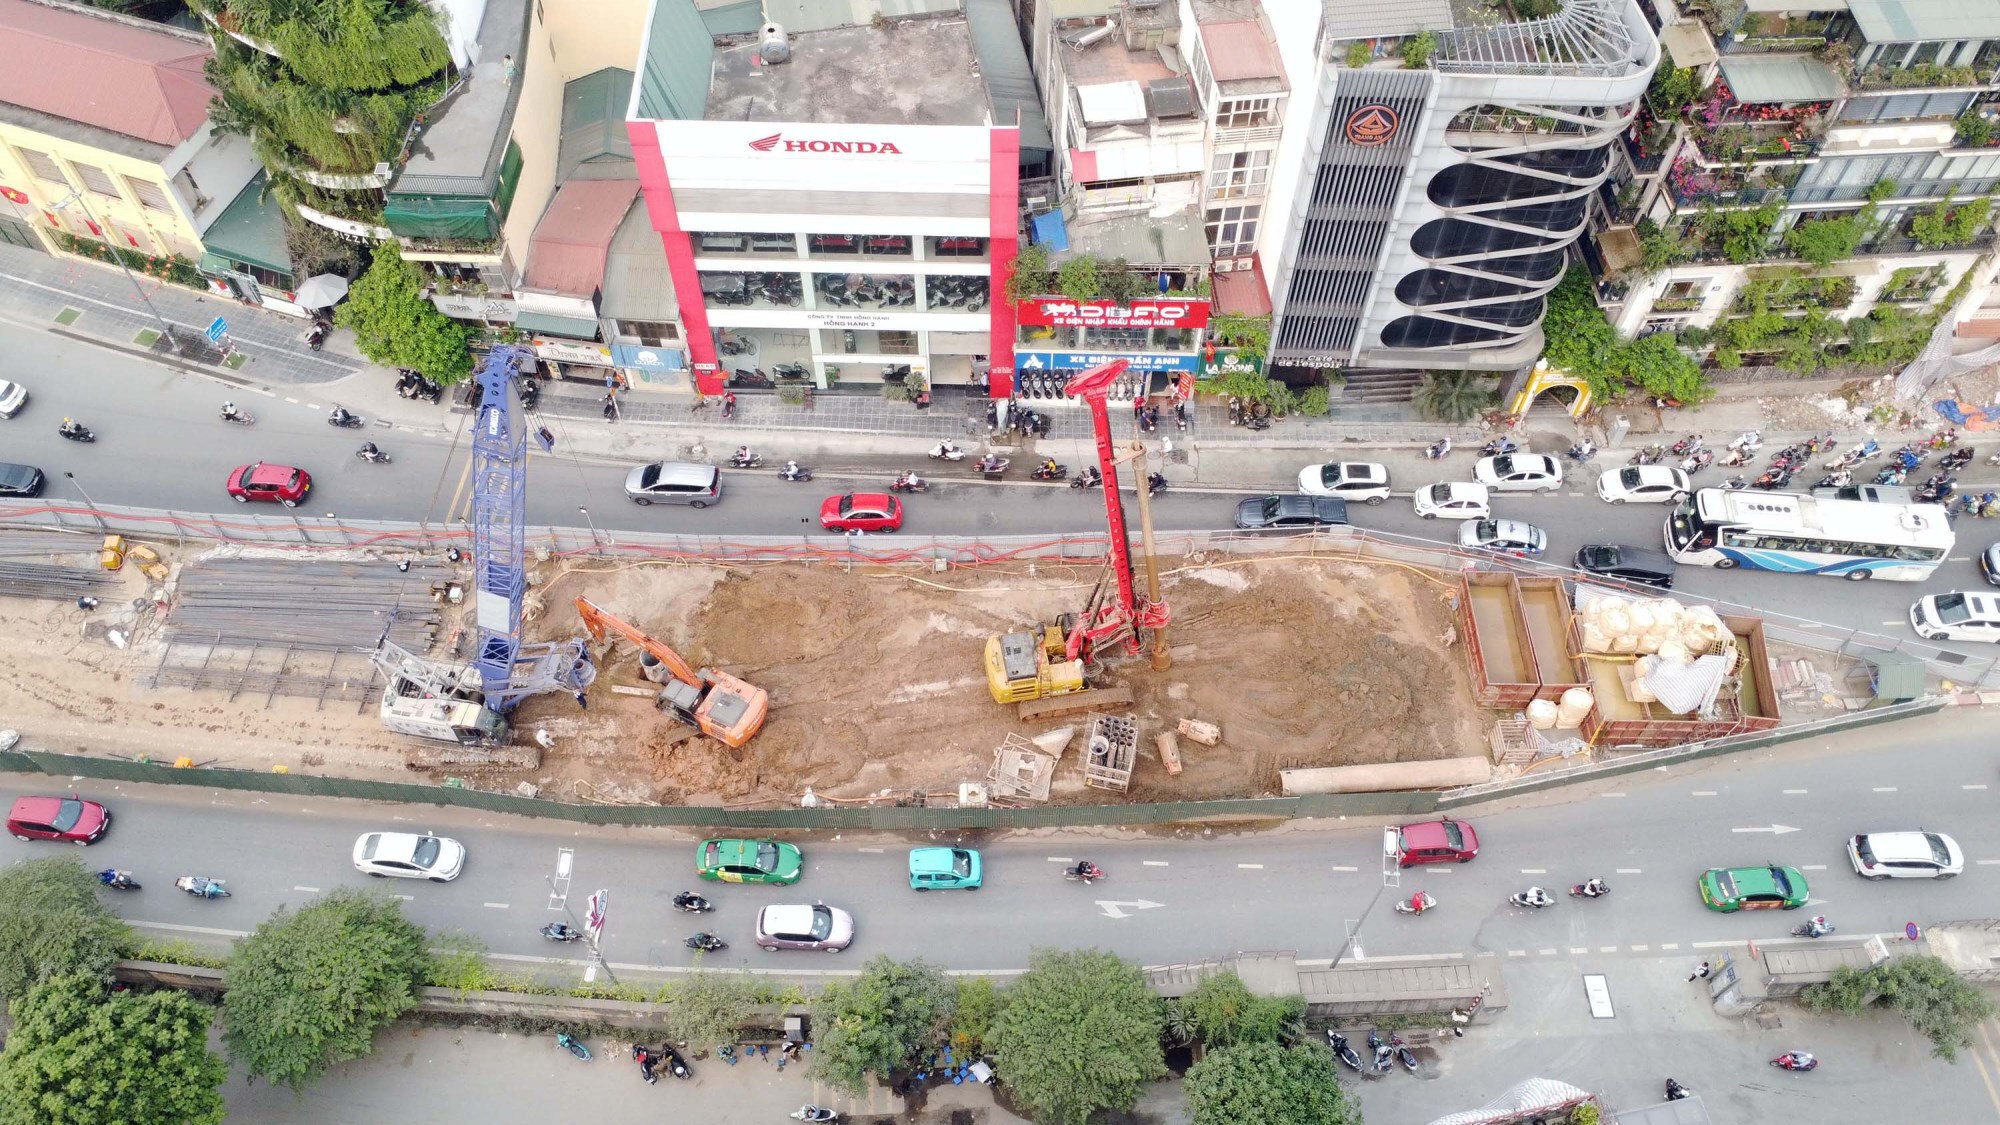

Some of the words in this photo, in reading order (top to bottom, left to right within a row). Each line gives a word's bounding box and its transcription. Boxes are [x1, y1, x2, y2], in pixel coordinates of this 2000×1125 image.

[783, 140, 903, 154] HONDA
[333, 230, 369, 245] PIZZA
[1069, 355, 1086, 363] XE
[1154, 357, 1180, 365] ANH
[1307, 354, 1333, 362] Café
[1278, 359, 1293, 367] de
[1295, 360, 1343, 369] l'espoir
